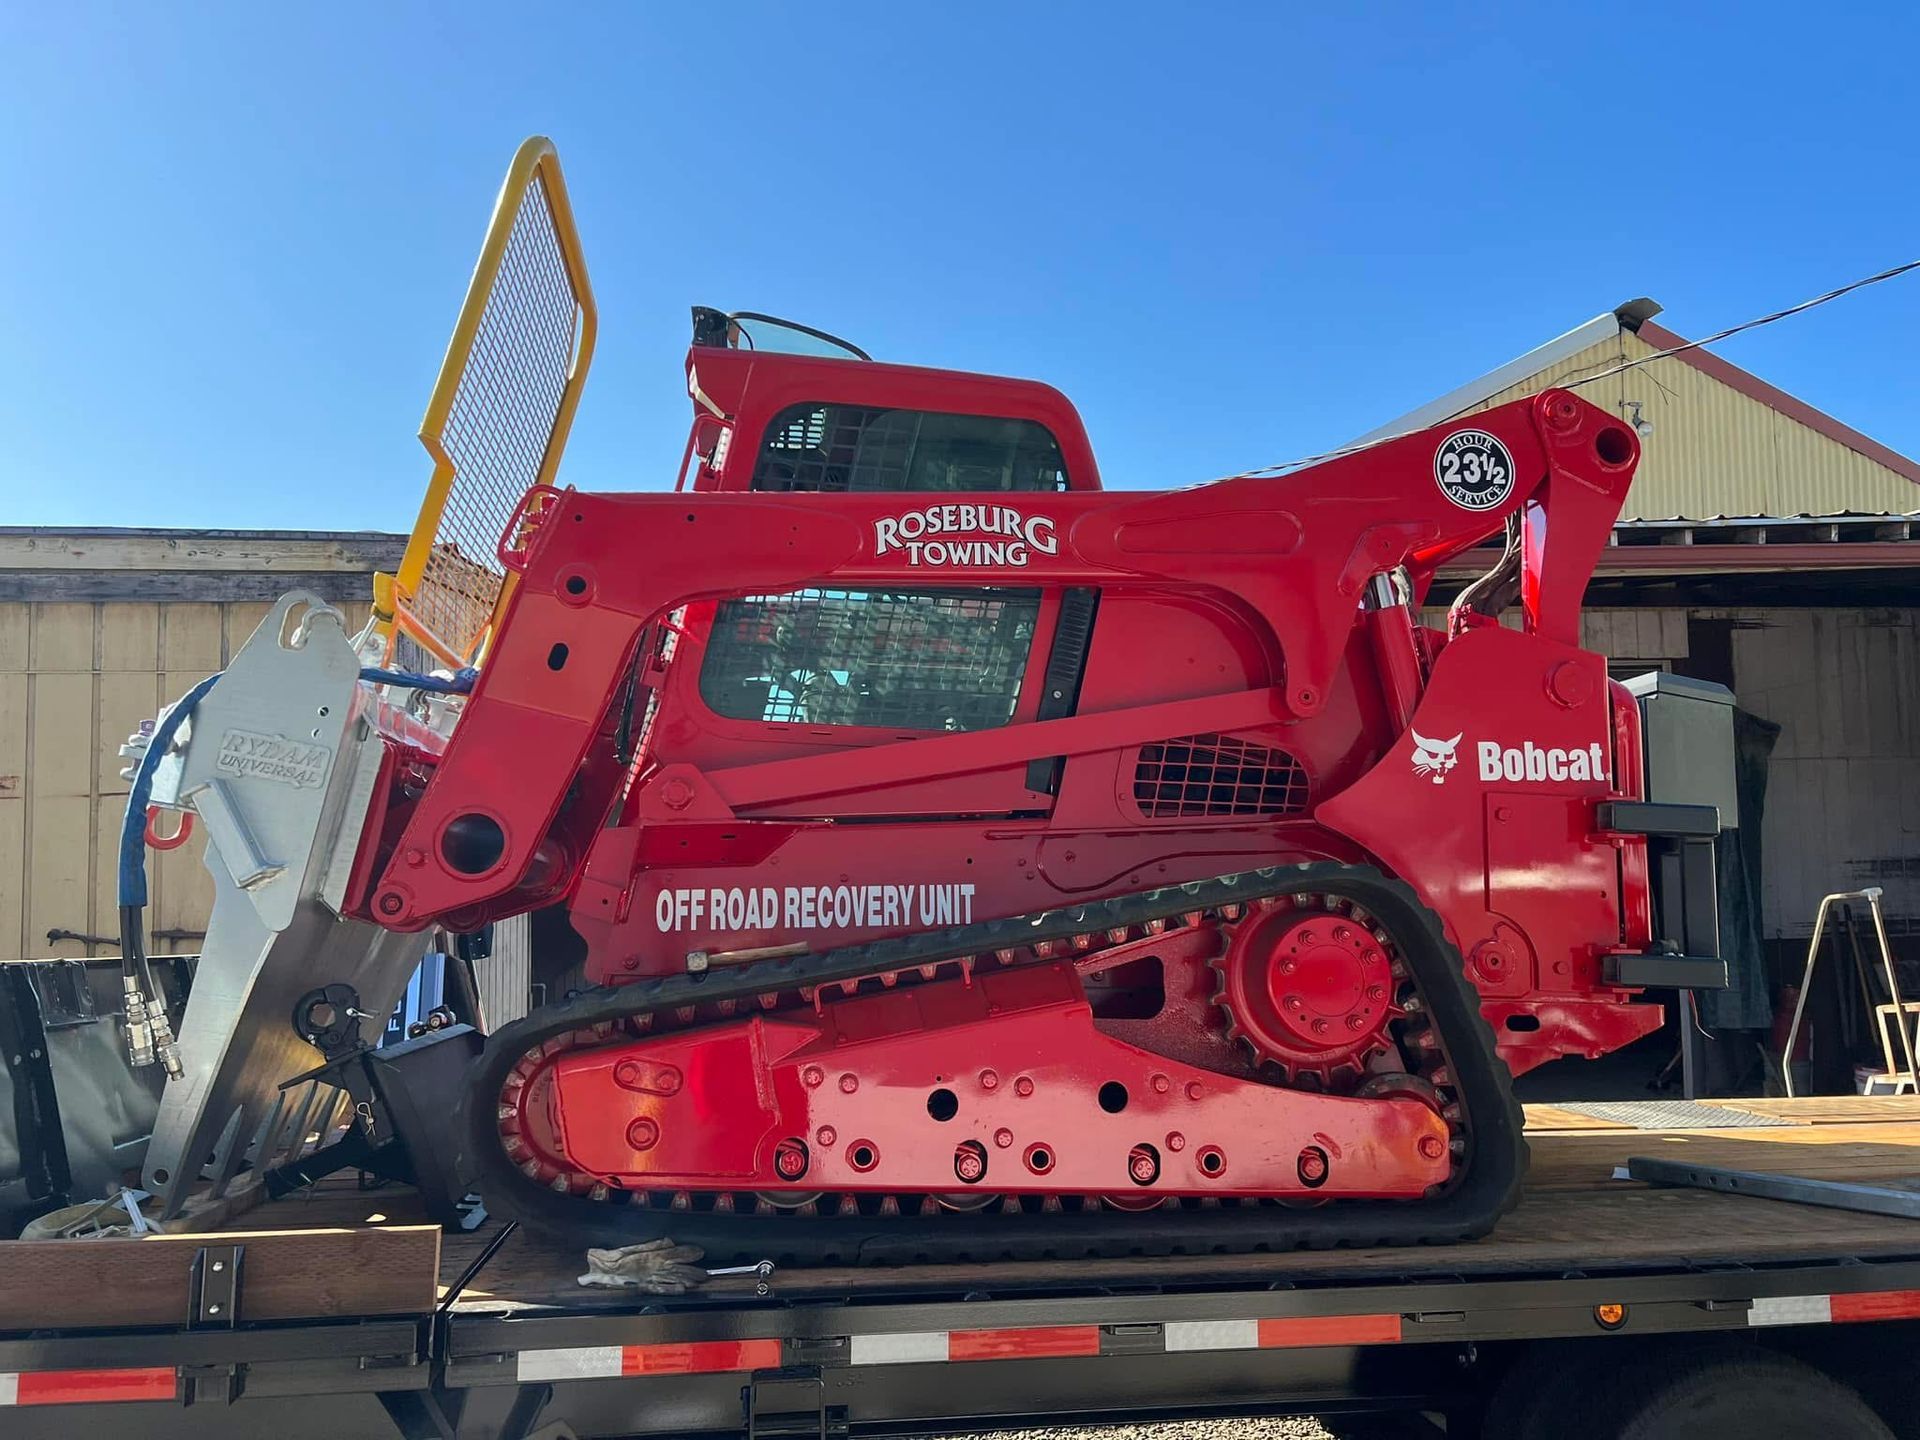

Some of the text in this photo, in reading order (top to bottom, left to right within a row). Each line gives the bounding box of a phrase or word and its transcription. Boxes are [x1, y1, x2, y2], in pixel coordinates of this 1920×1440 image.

[1452, 435, 1494, 450] HOUR
[1449, 484, 1504, 505] SERVICE
[875, 504, 1058, 555] ROSEBURG
[905, 541, 1029, 566] TOWING
[222, 733, 326, 769] RYDAM
[220, 753, 319, 783] UNIVERSAL
[656, 884, 975, 932] OFF ROAD RECOVERY UNIT
